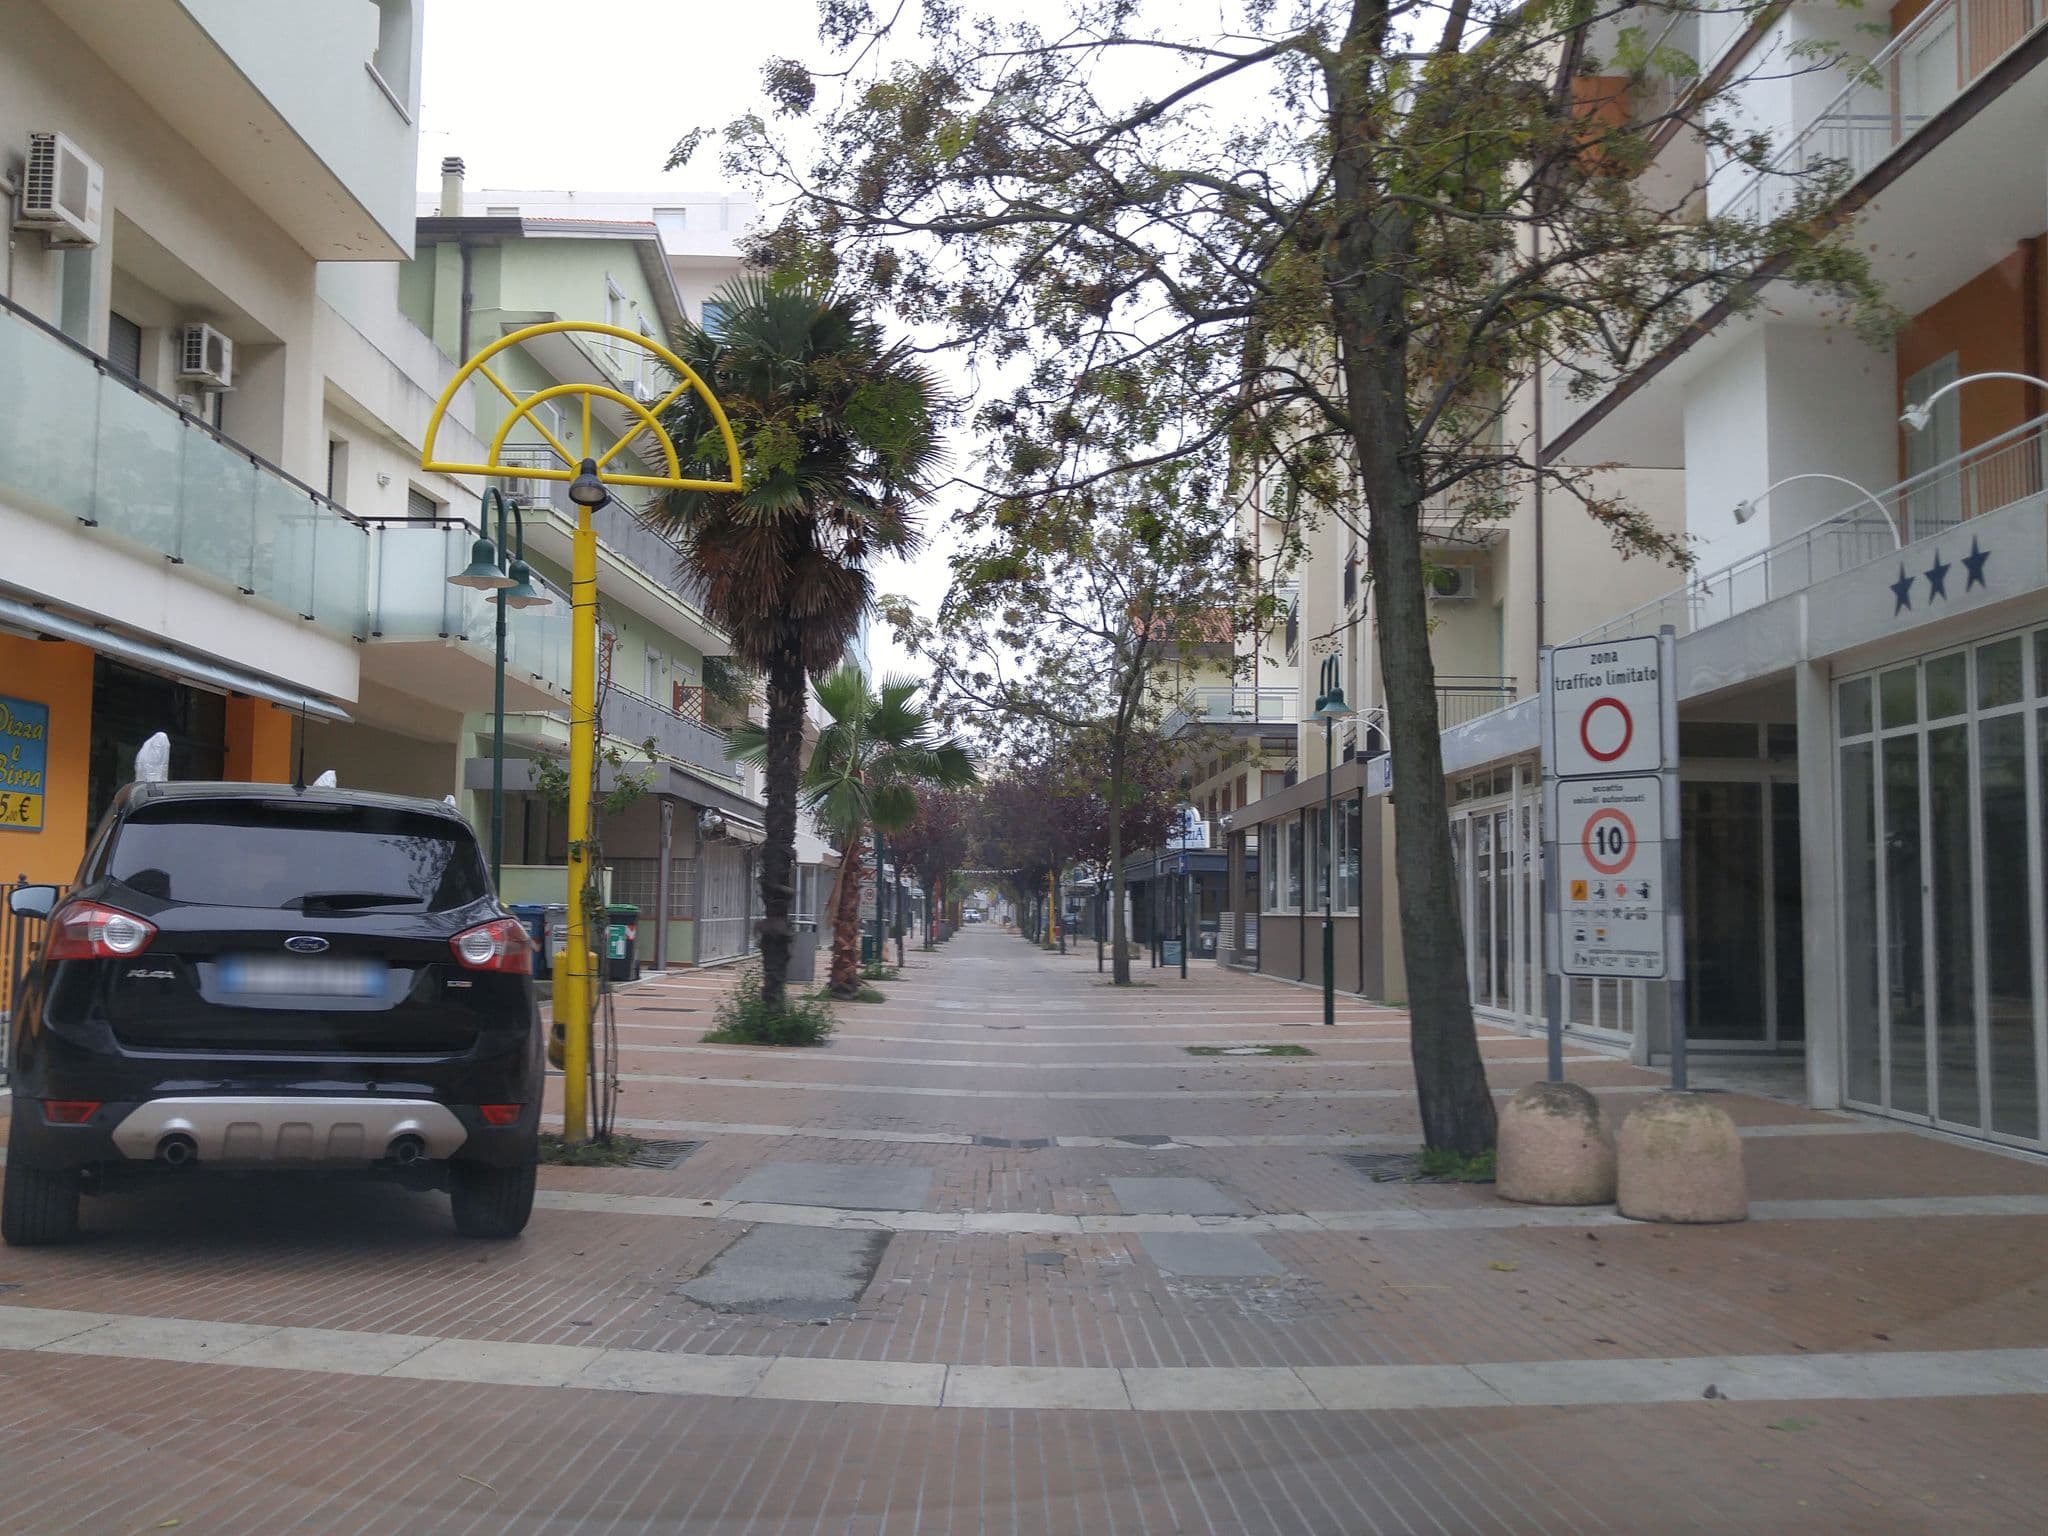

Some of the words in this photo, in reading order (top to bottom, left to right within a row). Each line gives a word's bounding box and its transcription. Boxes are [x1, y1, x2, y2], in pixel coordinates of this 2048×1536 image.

[1591, 651, 1619, 665] zona
[1555, 673, 1603, 691] traffico
[1605, 666, 1658, 686] limitato
[1596, 826, 1623, 855] 10
